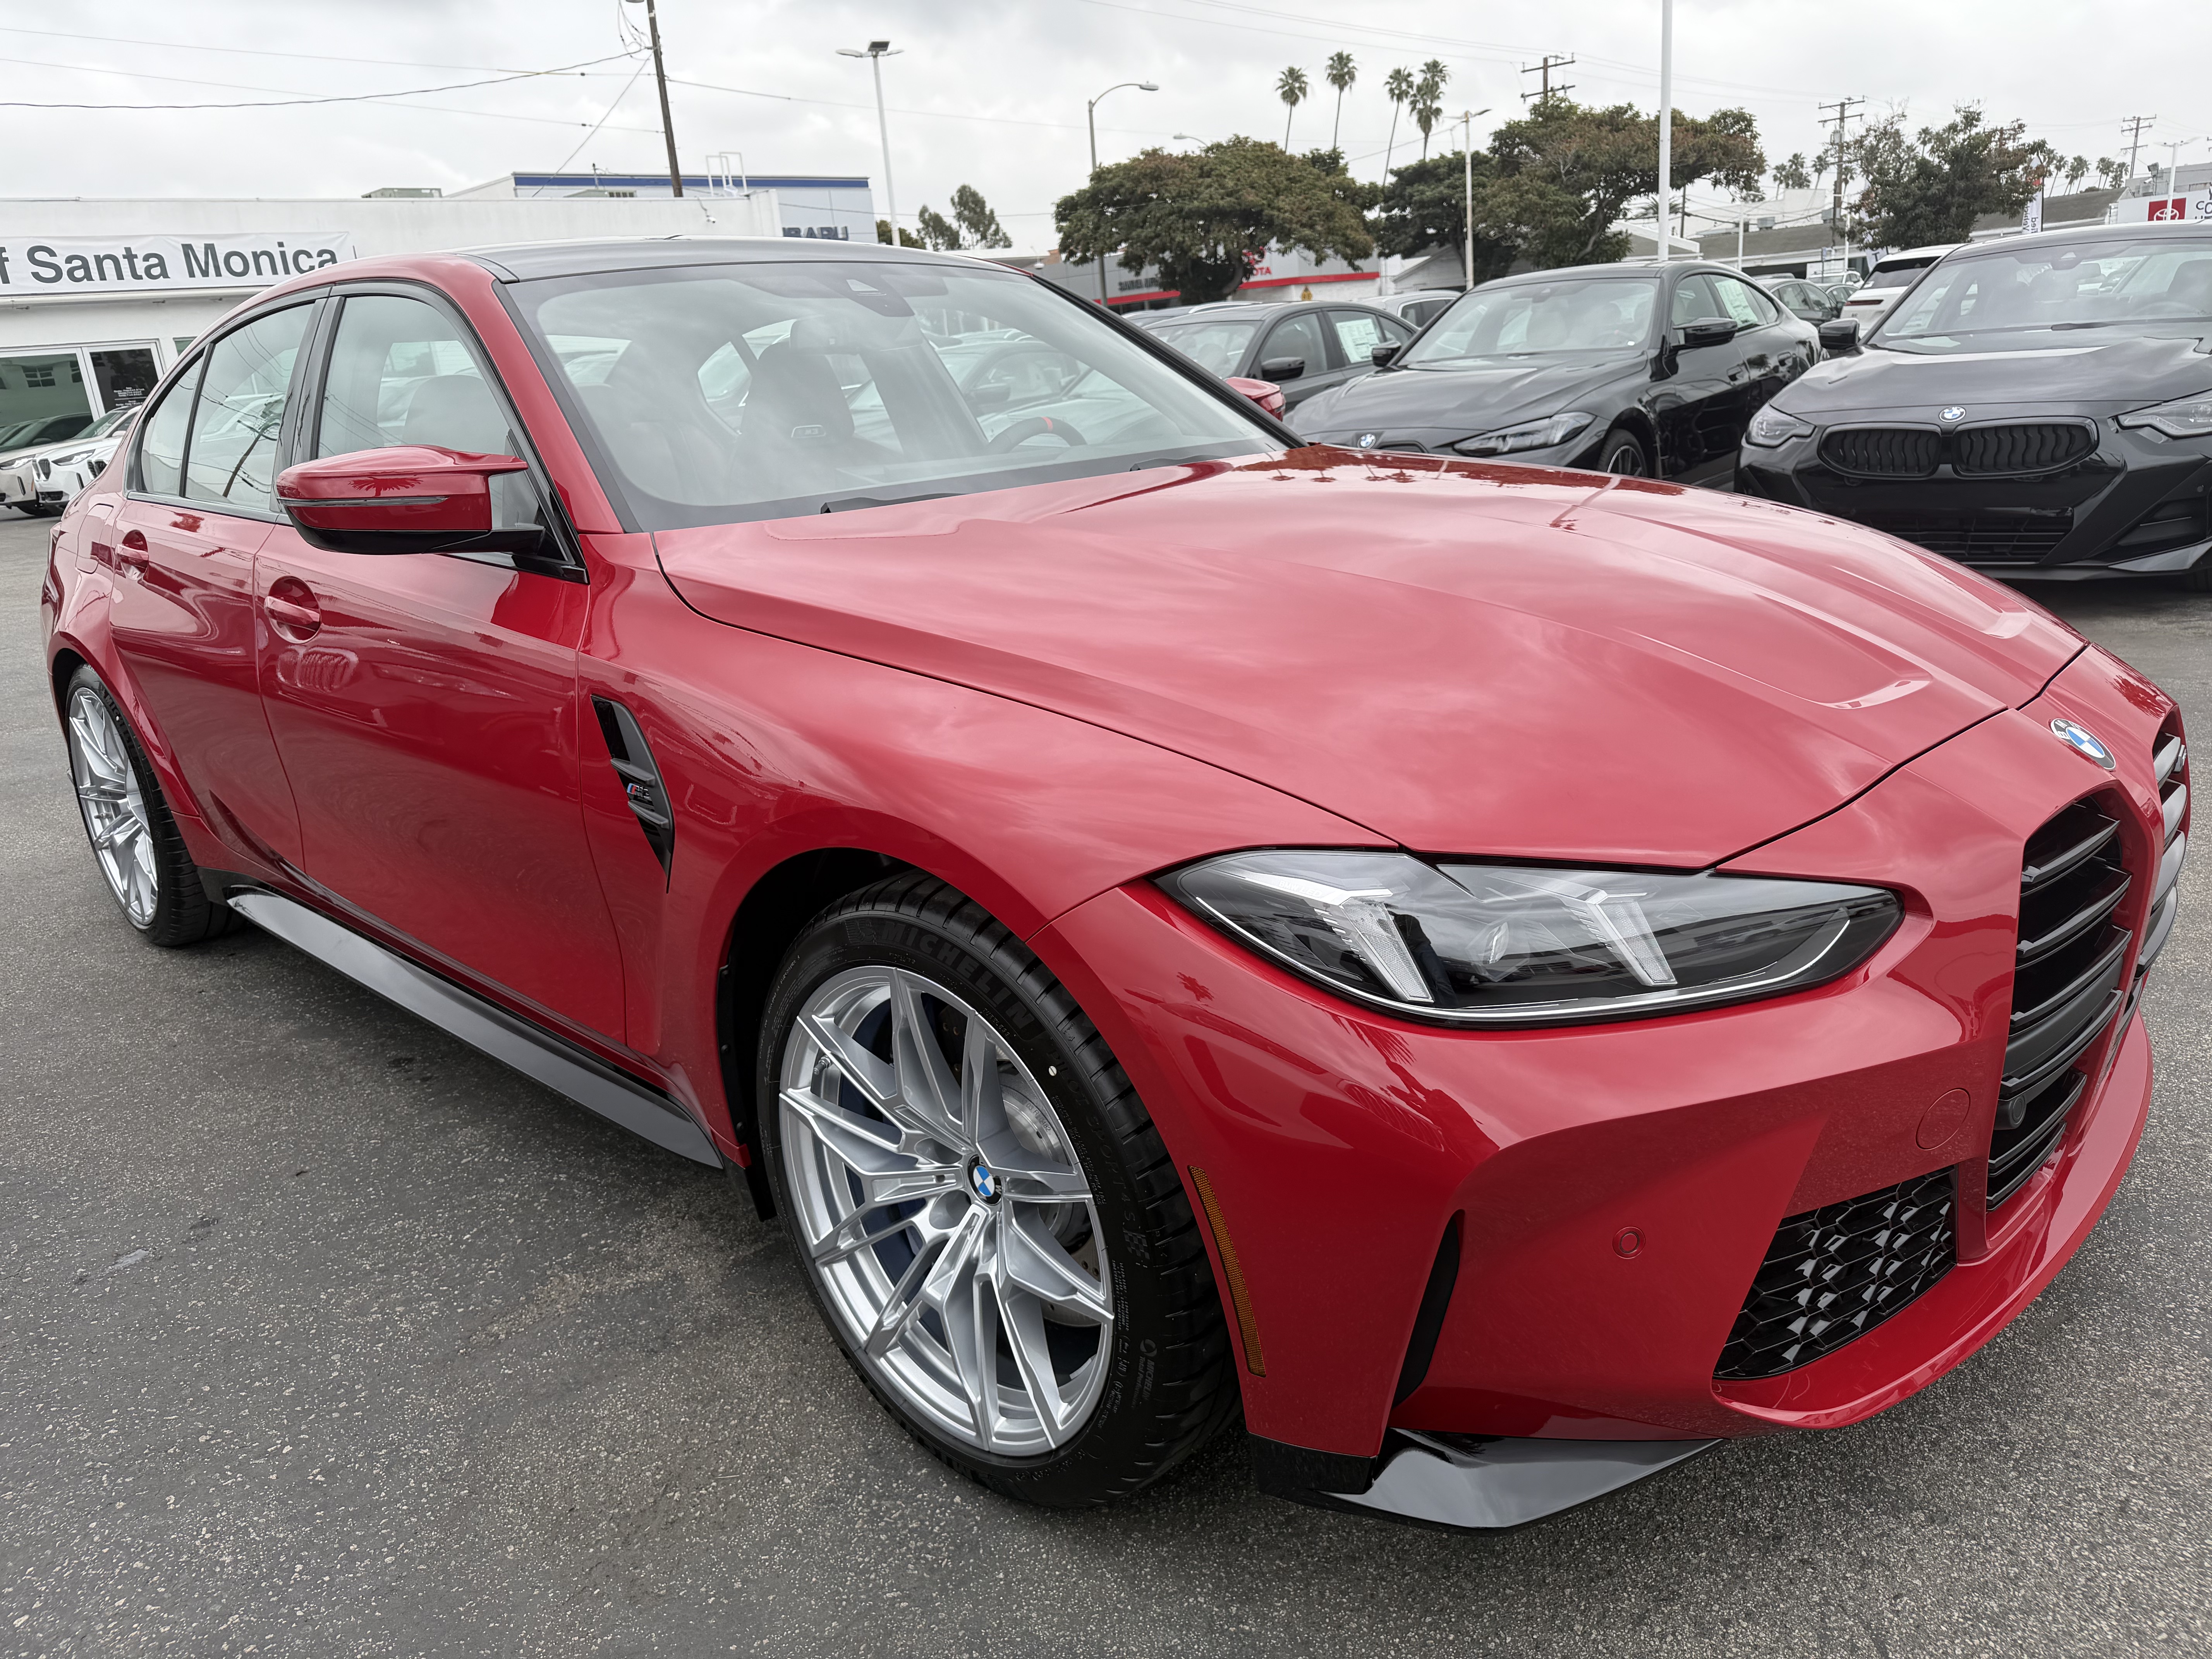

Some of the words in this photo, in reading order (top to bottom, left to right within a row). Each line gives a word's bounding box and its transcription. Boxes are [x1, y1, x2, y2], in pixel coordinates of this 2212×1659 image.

[782, 226, 849, 241] BARU
[27, 245, 171, 283] Santa
[181, 242, 338, 278] Monica
[1253, 266, 1272, 276] OTA
[881, 920, 1035, 1030] MICHELIN
[1142, 1358, 1155, 1401] MICHELIN
